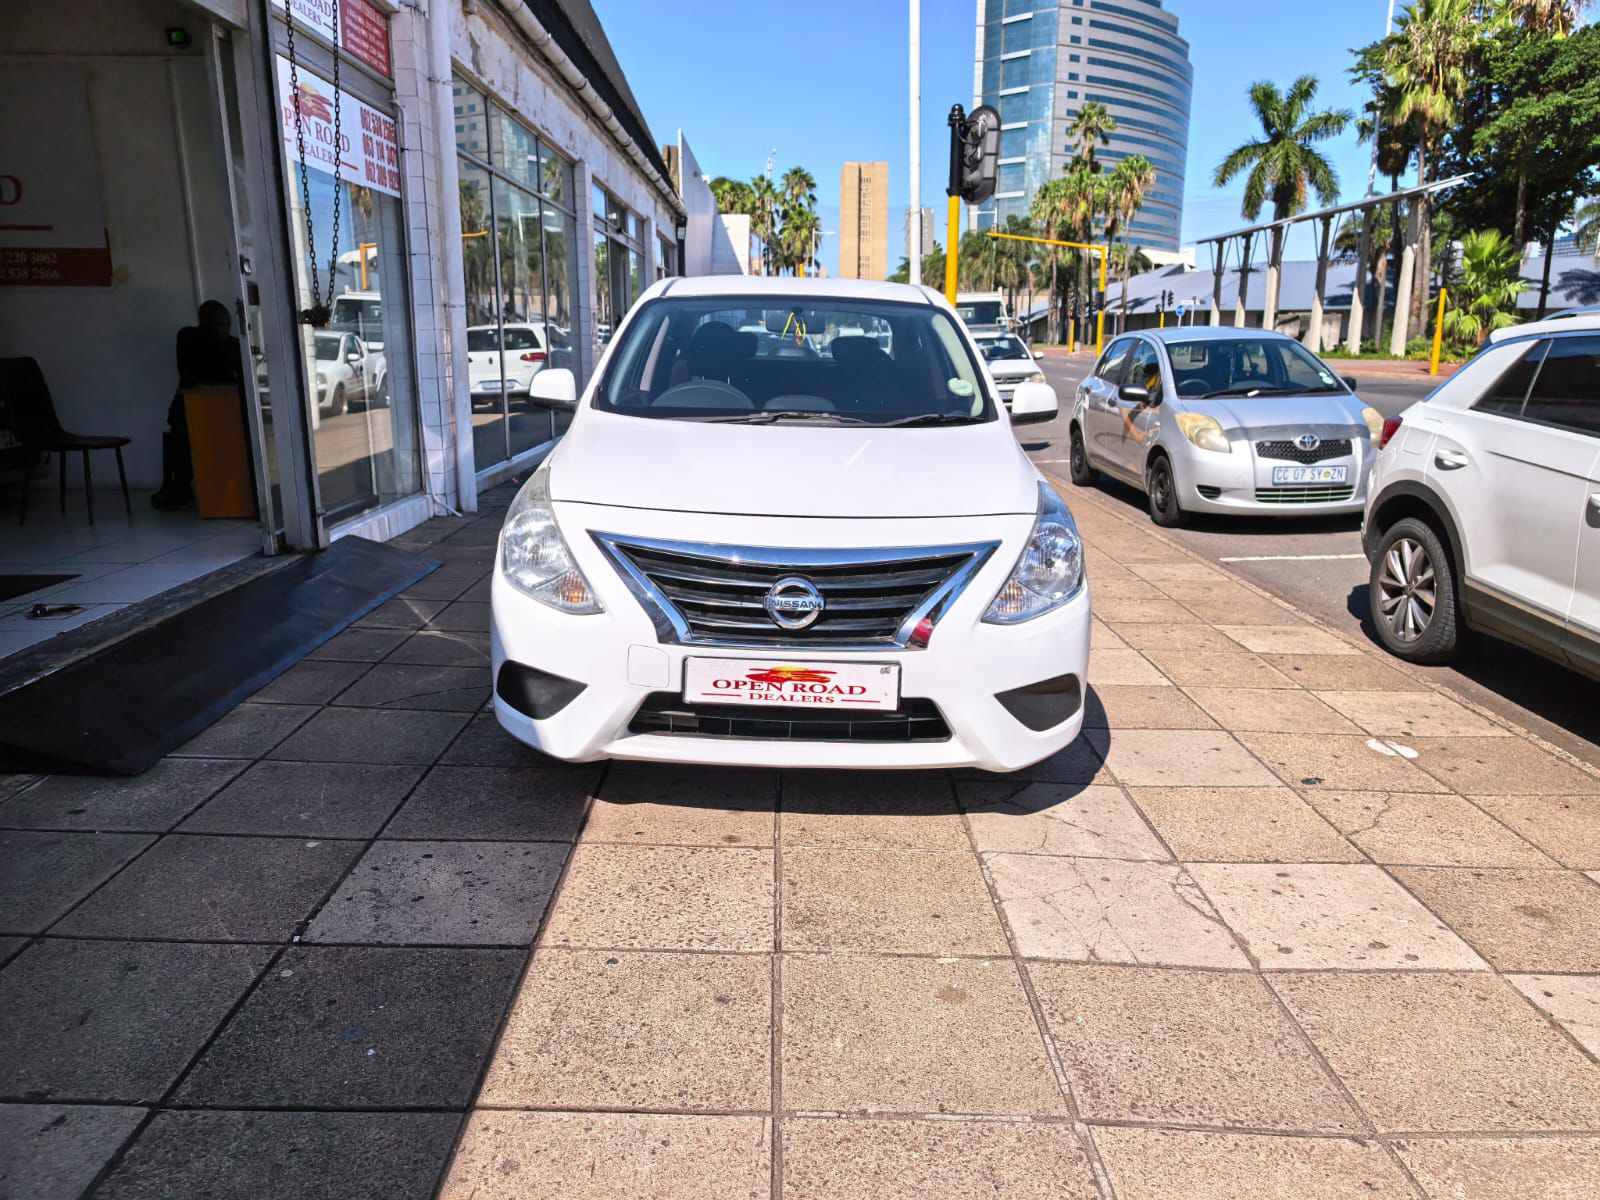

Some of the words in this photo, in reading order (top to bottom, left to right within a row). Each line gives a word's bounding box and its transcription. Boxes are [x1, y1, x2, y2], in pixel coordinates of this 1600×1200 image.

[314, 121, 350, 153] ROD
[296, 137, 337, 166] EALER
[1276, 469, 1289, 481] CC
[1293, 469, 1306, 481] 07
[1310, 469, 1323, 480] SY
[1331, 468, 1343, 480] ZN
[769, 600, 818, 609] NISSAN
[712, 678, 784, 693] OPEN
[793, 682, 867, 696] ROAD
[749, 692, 835, 704] DEALERS
